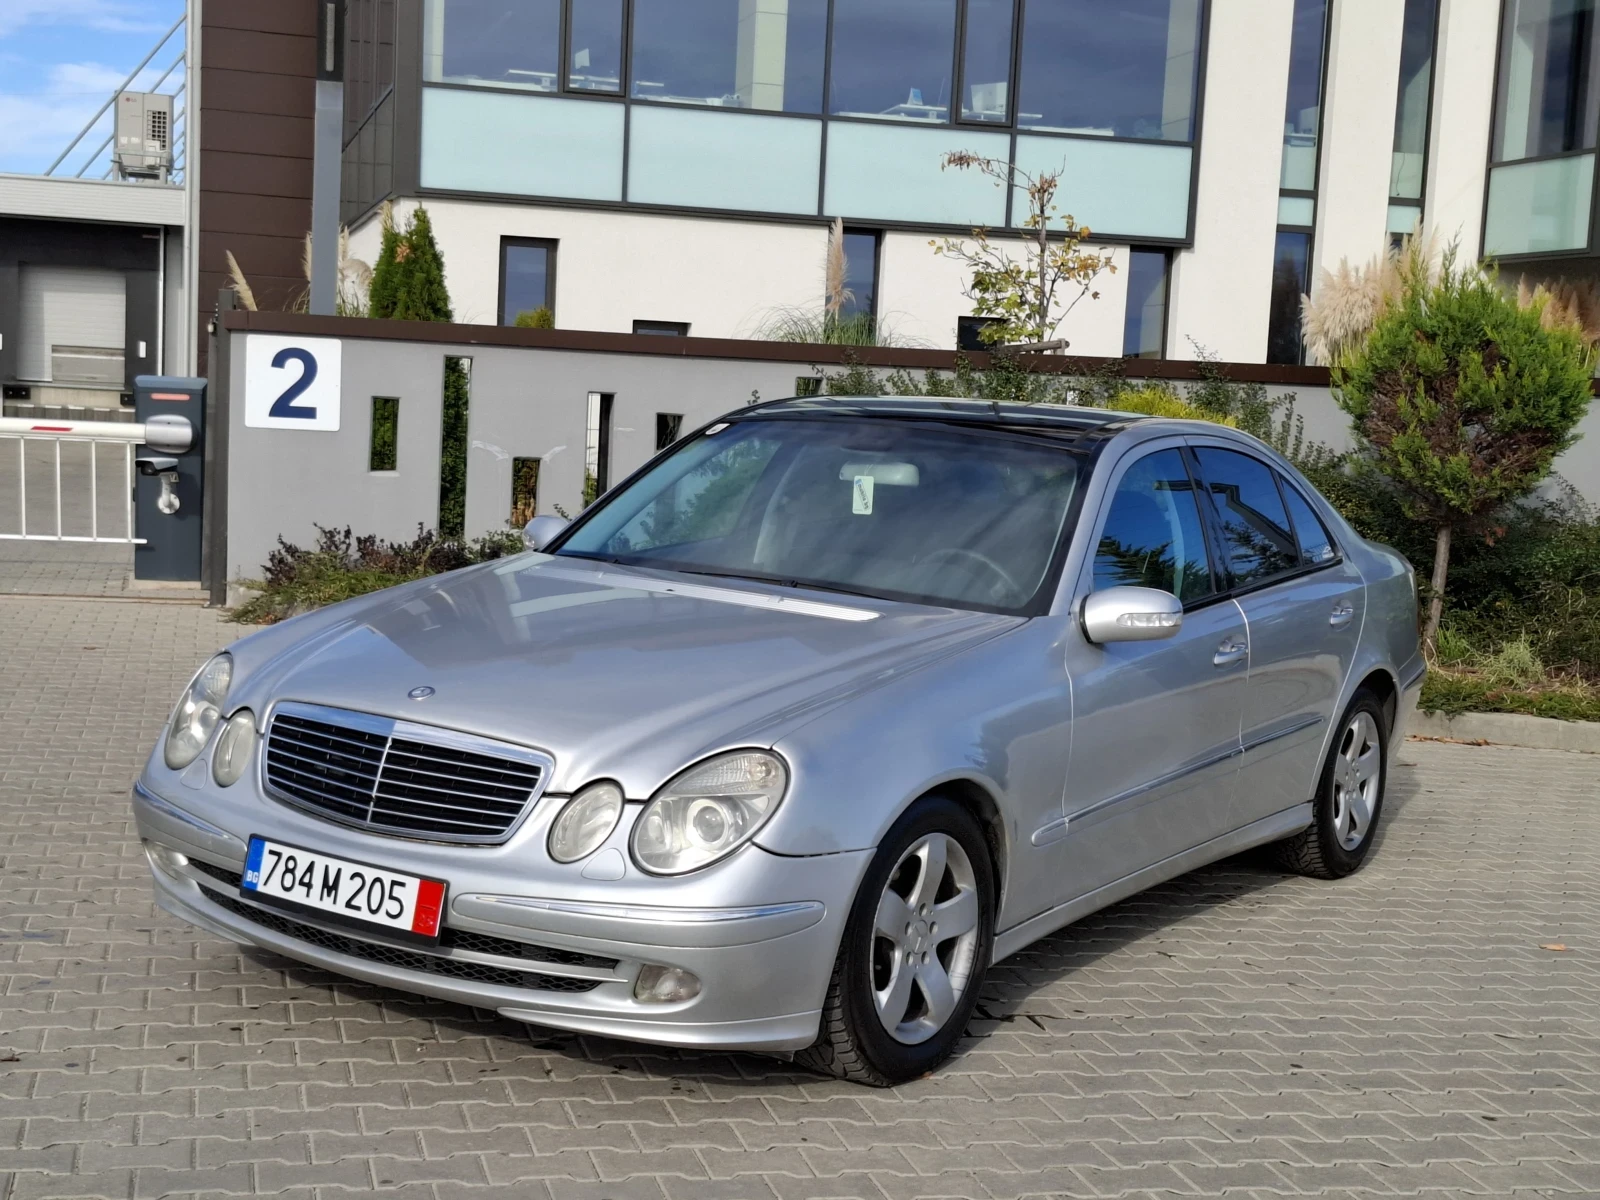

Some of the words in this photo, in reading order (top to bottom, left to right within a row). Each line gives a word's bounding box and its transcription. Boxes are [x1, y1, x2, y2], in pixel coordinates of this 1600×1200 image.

[268, 347, 318, 419] 2
[246, 869, 260, 883] BG
[263, 849, 316, 898] 784
[319, 863, 343, 905] M
[345, 871, 407, 919] 205
